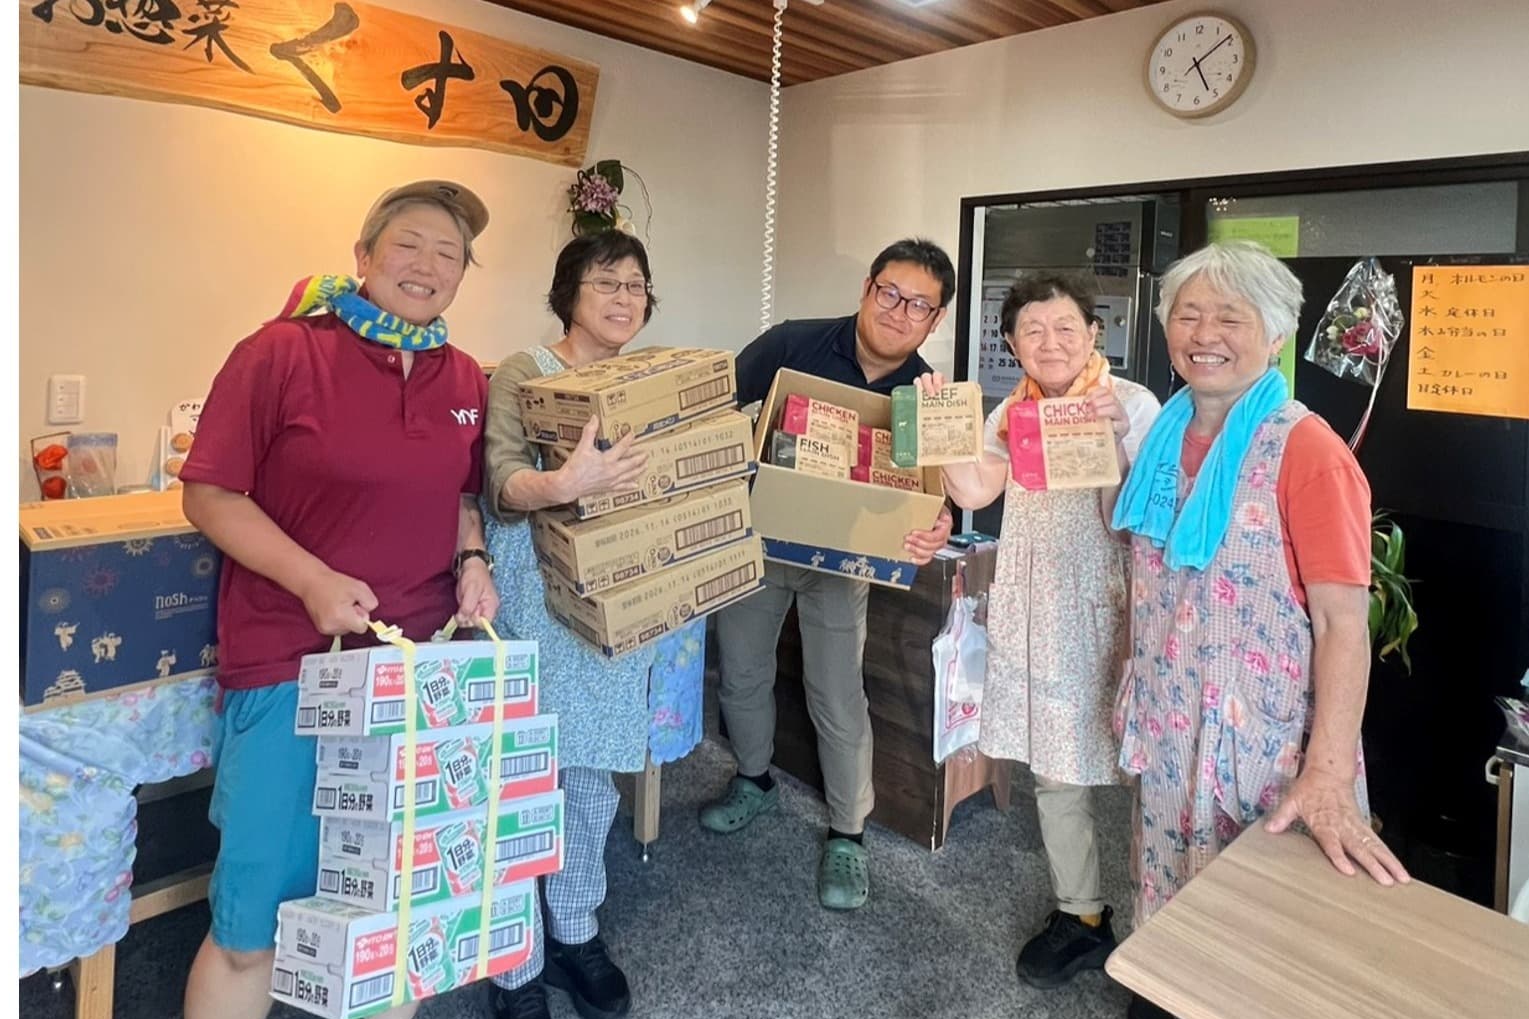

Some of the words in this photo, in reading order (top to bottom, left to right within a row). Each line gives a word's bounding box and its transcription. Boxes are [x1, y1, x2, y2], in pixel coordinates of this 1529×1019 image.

[1195, 24, 1204, 35] 12
[1215, 26, 1220, 35] 1
[1177, 33, 1186, 42] 11
[1163, 48, 1173, 57] 10
[1233, 54, 1238, 64] 3
[1159, 66, 1166, 75] 9
[1226, 73, 1232, 82] 4
[1163, 83, 1170, 93] 8
[1213, 89, 1219, 98] 5
[1176, 94, 1182, 103] 7
[1193, 96, 1200, 105] 6
[812, 402, 857, 421] CHICKEN
[1043, 401, 1090, 418] CHICK
[800, 438, 830, 453] FISH
[872, 470, 919, 488] CHICKEN
[155, 592, 188, 609] nosh
